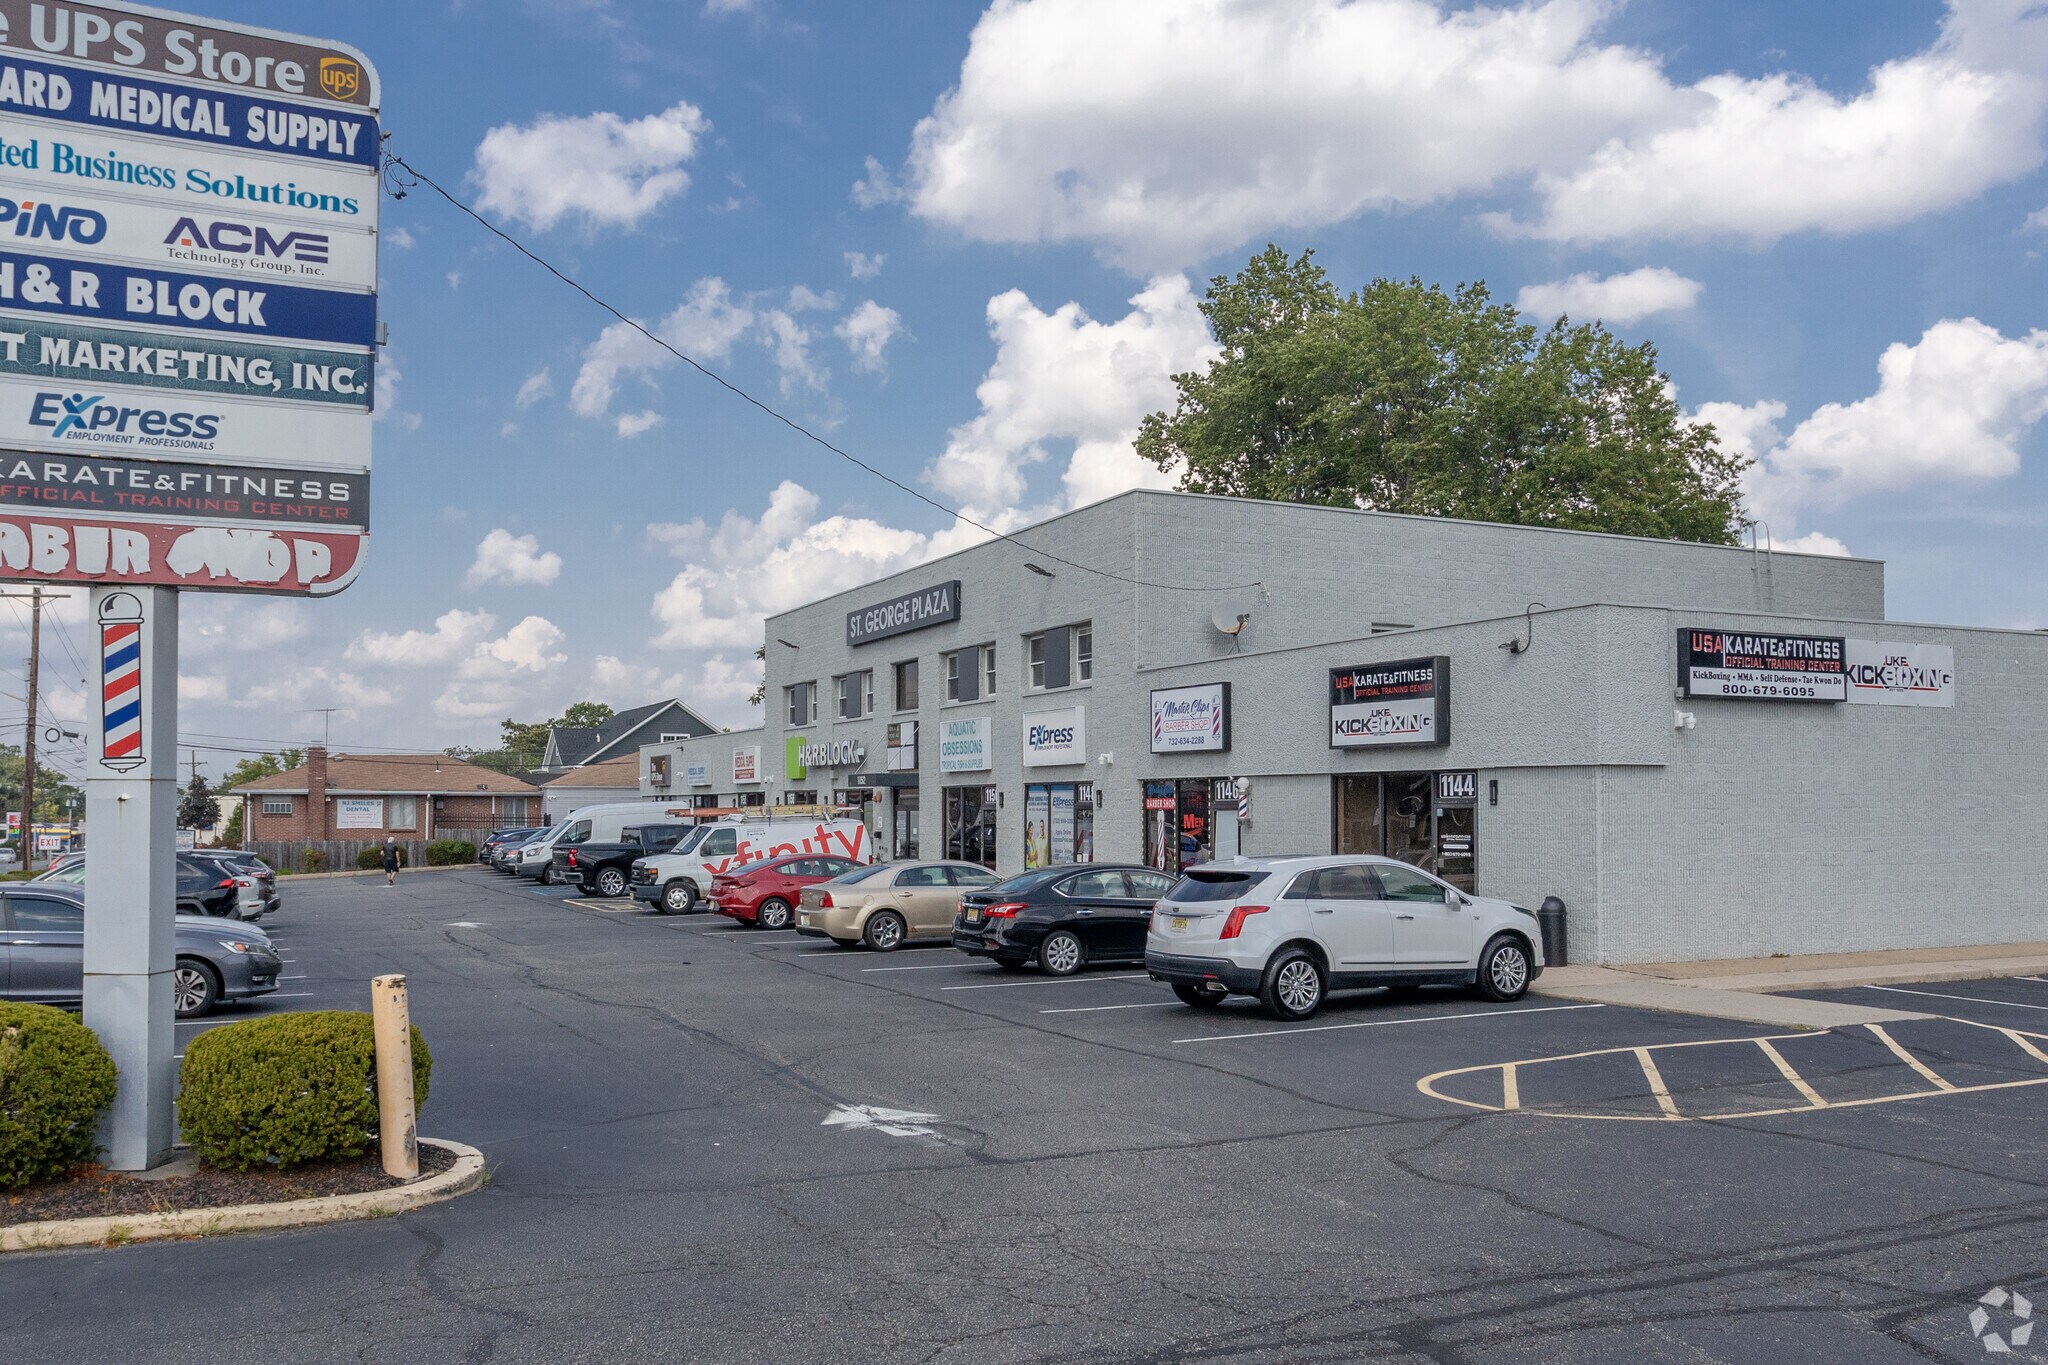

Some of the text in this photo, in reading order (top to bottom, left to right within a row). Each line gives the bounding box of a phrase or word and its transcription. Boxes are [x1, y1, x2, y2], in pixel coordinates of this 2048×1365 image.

[30, 3, 146, 66] UPS
[164, 29, 306, 93] Store
[323, 68, 357, 90] ups
[89, 81, 231, 137] MEDICAL
[246, 105, 361, 156] SUPPLY
[50, 142, 176, 190] Business
[185, 168, 359, 215] Solutions
[163, 217, 329, 264] ACME
[167, 247, 325, 276] Technology Group, Inc.
[126, 276, 267, 327] BLOCK
[41, 336, 282, 392] MARKETING,
[293, 362, 367, 395] INC.
[66, 431, 215, 450] EMPLOYMENT PROFESSIONALS
[0, 458, 350, 502] ARATE&FITNESS
[114, 493, 240, 512] TRAINING
[251, 502, 350, 520] CENTER
[850, 588, 950, 638] ST. GEORGE PLAZA
[1692, 633, 1840, 659] USA KARATE&FITNESS
[1725, 656, 1841, 672] OFFICIAL TRAINING CENTER
[1335, 668, 1433, 689] USA KARATE&FITNESS
[1693, 671, 1842, 685] KickBoxing MMA Self Defense Tae Kwon Do
[1355, 683, 1433, 697] OFFICIAL TRAINING CENTER
[1722, 684, 1815, 697] 800-679-6095
[948, 721, 976, 737] AQUATIC
[1165, 719, 1208, 731] BARBER SHOP
[1335, 714, 1433, 735] KICKBOXING
[942, 739, 983, 756] OBSESSIONS
[1029, 725, 1074, 751] Express
[798, 740, 858, 767] H&R BLOCK
[1216, 781, 1239, 799] 1146
[1441, 775, 1475, 796] 1144
[1146, 798, 1176, 808] BARBER SHOP
[40, 838, 60, 847] EXIT
